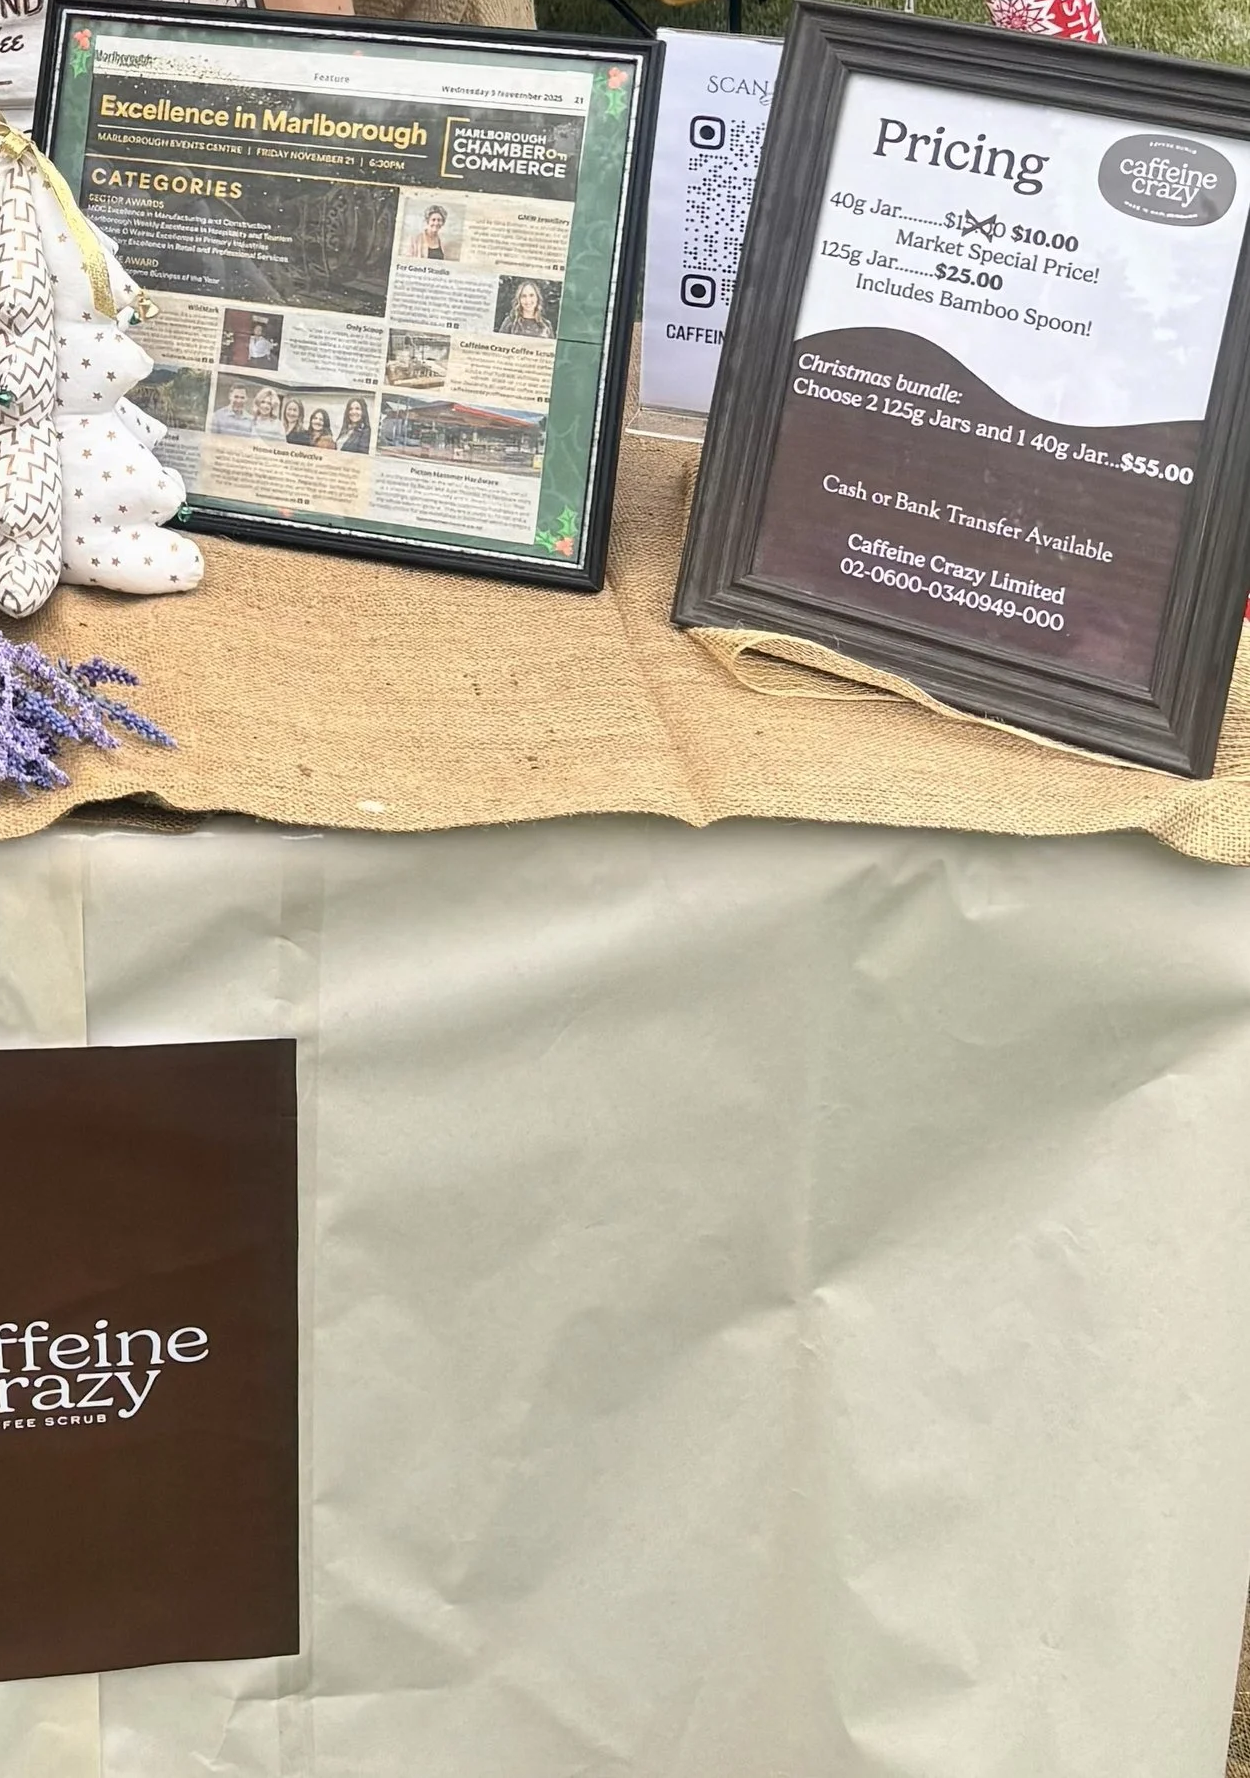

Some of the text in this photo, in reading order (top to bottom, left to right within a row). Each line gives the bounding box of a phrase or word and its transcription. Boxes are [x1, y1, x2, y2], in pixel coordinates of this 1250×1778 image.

[441, 85, 489, 98] Wednesday
[497, 90, 542, 102] November
[707, 75, 768, 96] SCAN
[100, 94, 427, 149] Excellence in Marlborough
[454, 127, 547, 144] MARLBOROUGH
[97, 133, 170, 148] MARLBOROUGH
[169, 138, 205, 150] EVENTS
[206, 142, 242, 154] CENTRE
[256, 148, 289, 159] FRIDAY
[290, 151, 344, 165] NOVEMBER
[368, 158, 405, 171] 6:30PM
[452, 139, 568, 162] CHAMBER OF
[872, 117, 1050, 196] Pricing
[451, 154, 567, 179] COMMERCE
[1119, 157, 1218, 189] caffeine
[91, 168, 243, 199] CATEGORIES
[1131, 177, 1199, 208] crazy
[88, 193, 165, 209] SECTOR AWARDS
[107, 207, 145, 217] Excellence
[154, 210, 207, 226] Manufacturing
[207, 217, 222, 226] and
[223, 218, 272, 230] Construction
[160, 222, 198, 233] Excellence
[830, 191, 868, 215] 40g
[1010, 224, 1079, 253] $10.00
[127, 238, 165, 249] Excellence
[820, 240, 863, 266] 125g
[896, 228, 1100, 283] Market Special Price!
[124, 257, 159, 268] AWARD
[855, 273, 1093, 337] Includes Bamboo Spoon!
[459, 341, 490, 350] Caffeine
[490, 345, 511, 354] Crazy
[511, 347, 534, 356] Coffee
[798, 353, 963, 404] Christmas bundle:
[793, 377, 862, 407] Choose
[865, 394, 878, 411] 2
[882, 398, 926, 426] 125g
[929, 409, 971, 433] Jars
[975, 423, 1013, 443] and
[1016, 429, 1026, 447] 1
[1030, 433, 1070, 460] 40g
[822, 474, 1114, 563] Cash or Bank Transfer Available
[847, 533, 1066, 605] Caffeine Crazy Limited
[840, 557, 1065, 632] 02-0600-0340949-000
[44, 1413, 107, 1427] SCRUB
